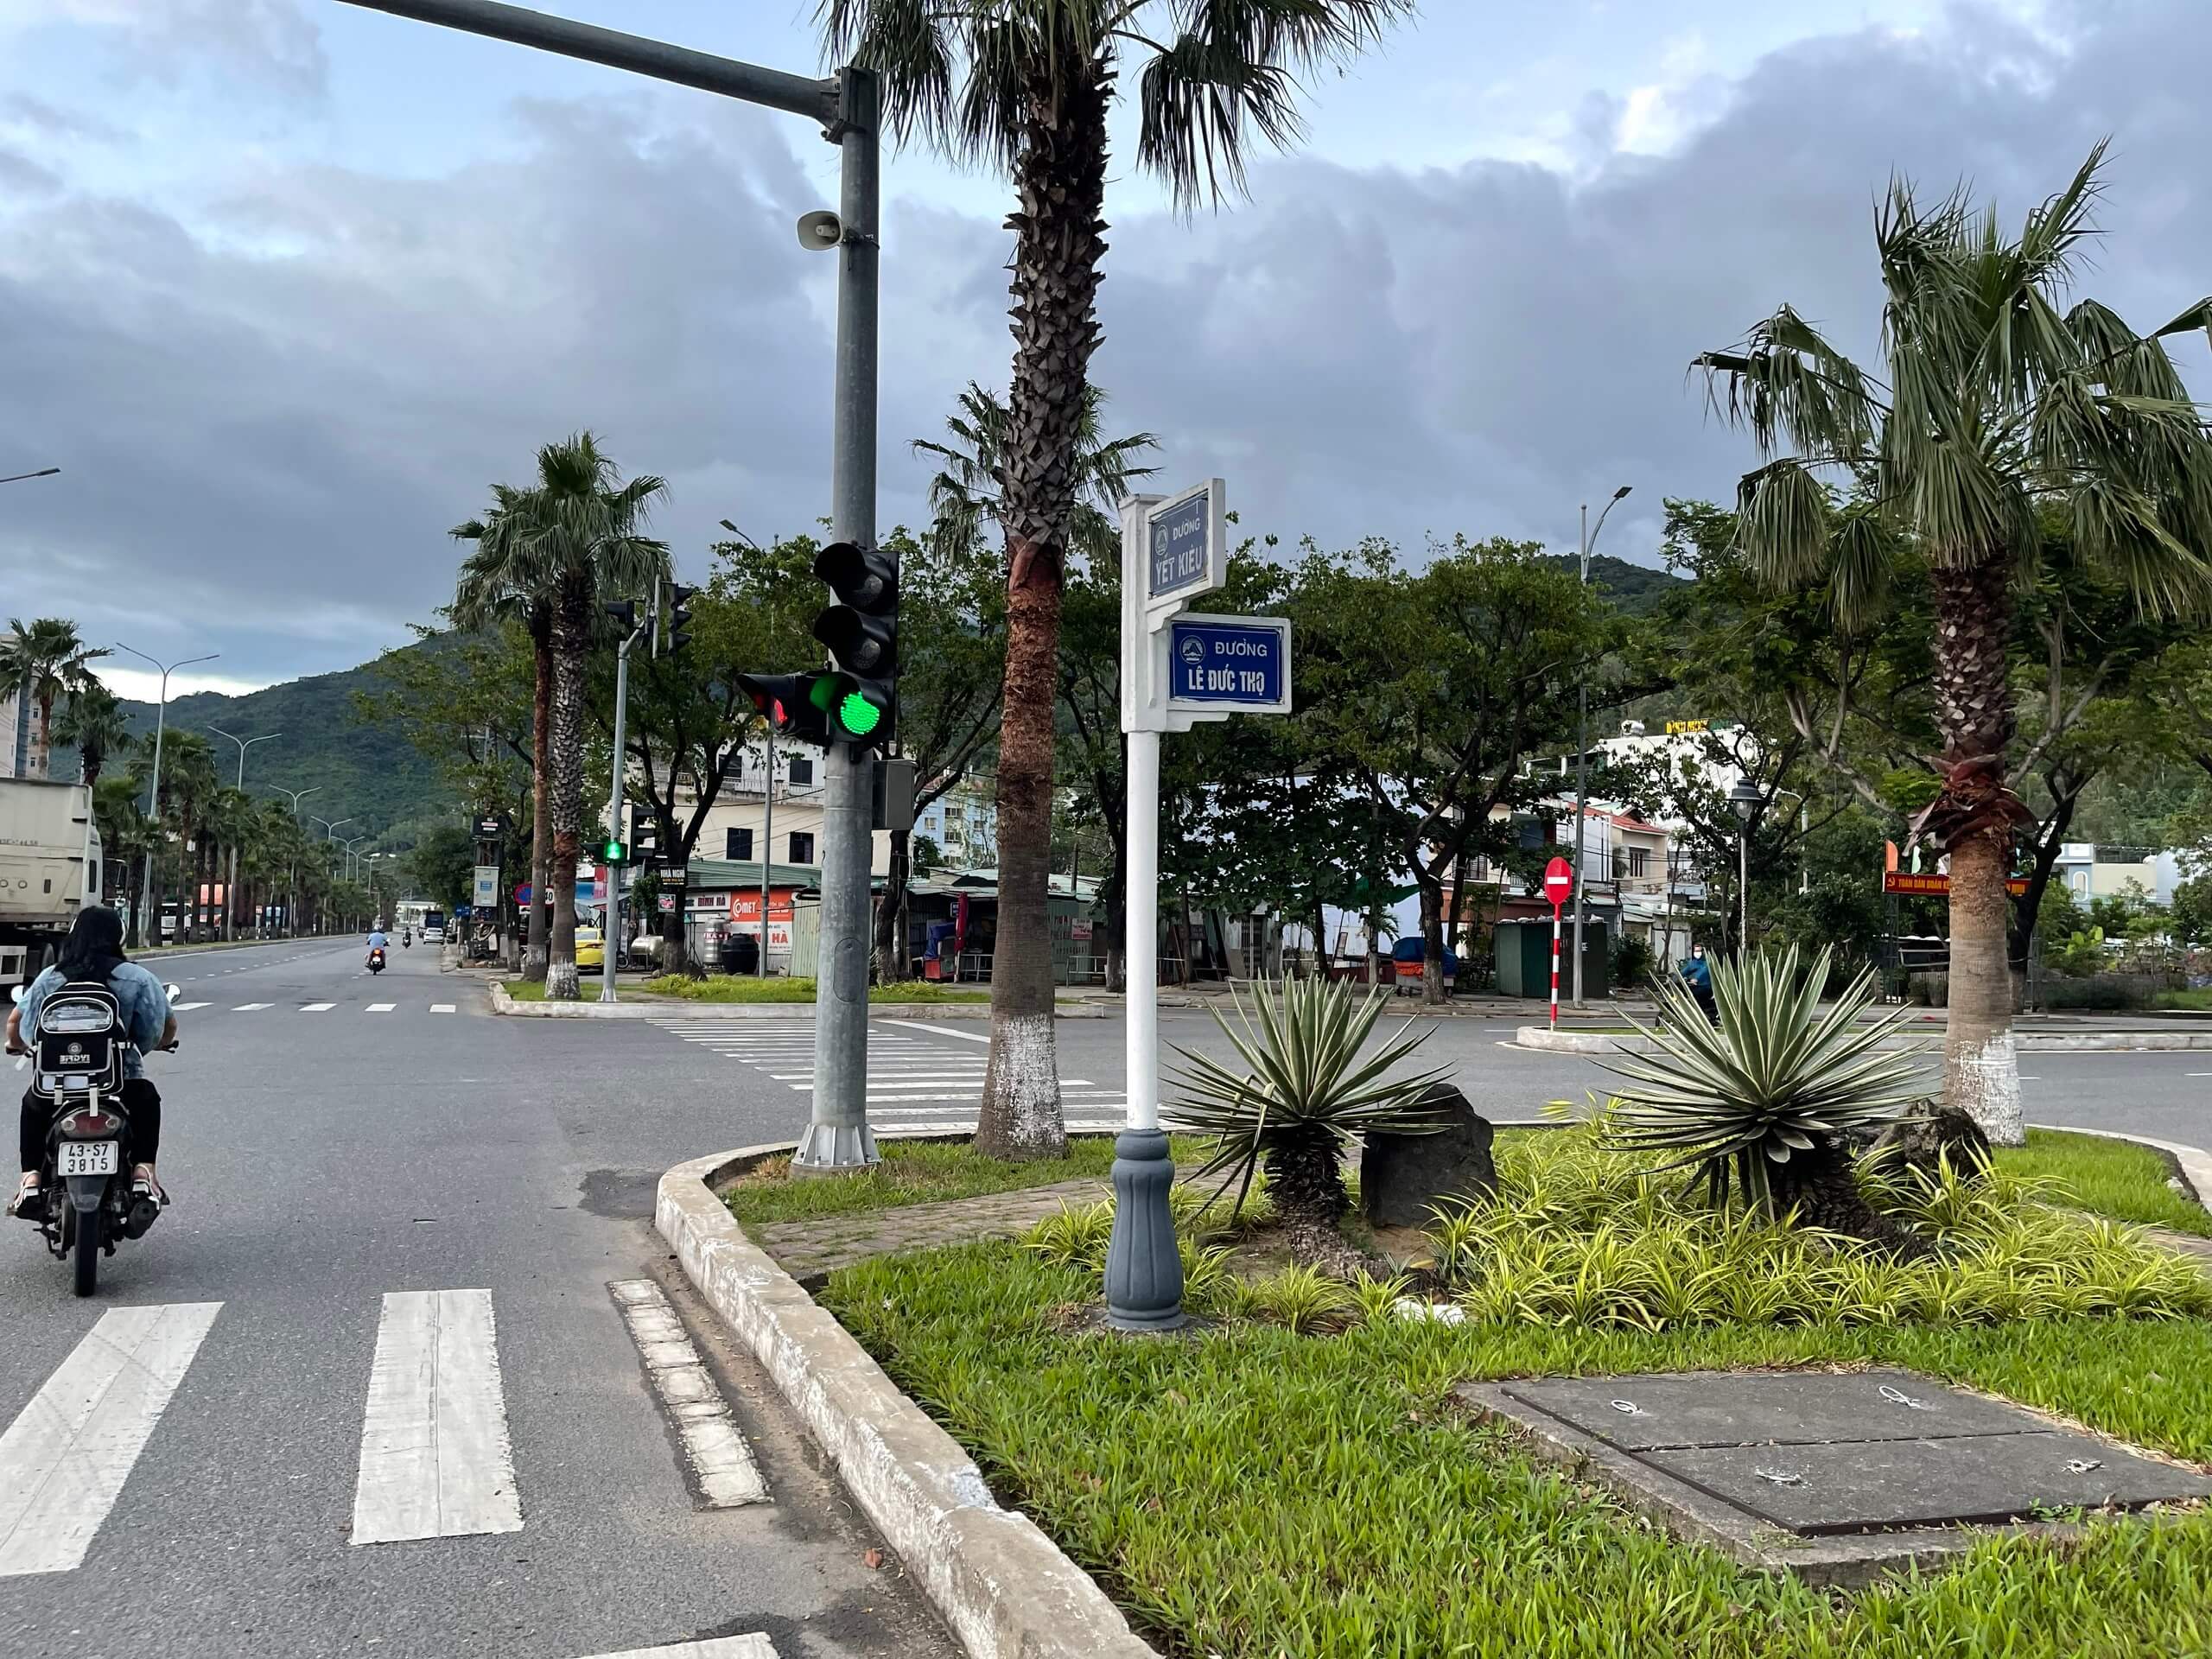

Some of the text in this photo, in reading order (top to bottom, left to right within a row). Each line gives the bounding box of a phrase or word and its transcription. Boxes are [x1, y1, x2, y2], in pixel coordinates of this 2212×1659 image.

[1215, 638, 1268, 657] ĐƯỜNG
[1188, 664, 1265, 696] LÊ ĐỨC THỌ
[68, 1144, 109, 1157] 43-S7
[67, 1158, 108, 1173] 3815
